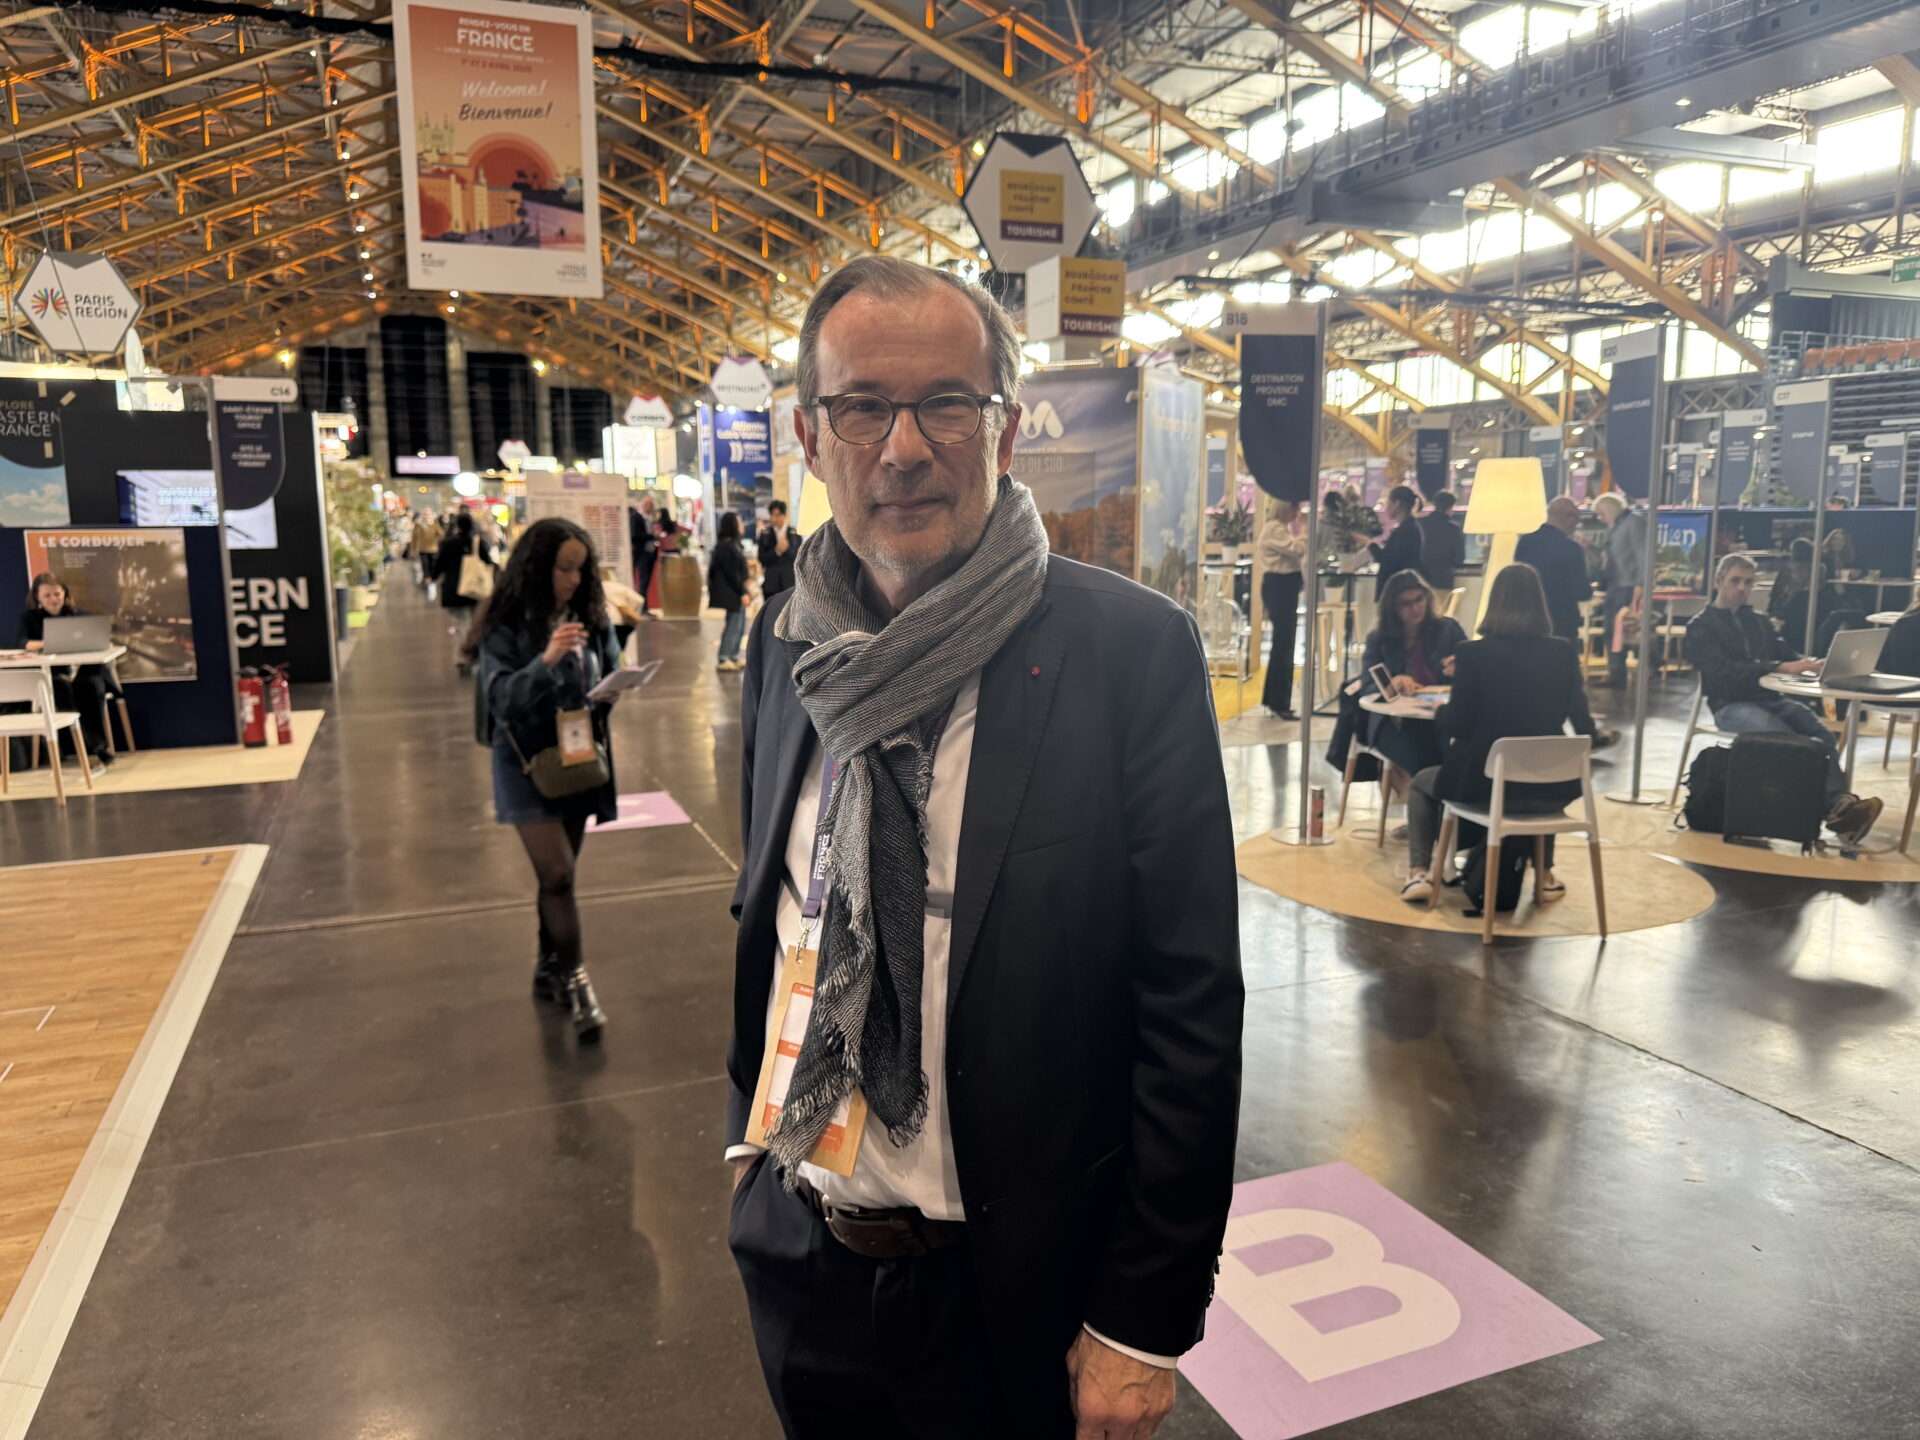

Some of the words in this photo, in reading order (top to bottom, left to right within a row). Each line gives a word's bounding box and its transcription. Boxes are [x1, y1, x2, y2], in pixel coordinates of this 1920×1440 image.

[457, 28, 534, 53] FRANCE
[462, 80, 548, 98] Welcome!
[458, 101, 552, 121] Bienvenue!
[1006, 225, 1058, 239] TOURISME
[74, 293, 116, 306] PARIS
[75, 307, 128, 319] REGION
[1250, 374, 1304, 384] DESTINATION
[1255, 386, 1299, 395] PROVENCE
[1266, 397, 1288, 407] DMC
[39, 536, 57, 548] LE
[60, 535, 145, 550] CORBUSIER
[229, 577, 310, 612] ERN
[233, 614, 288, 648] CE
[1214, 1208, 1462, 1384] B
